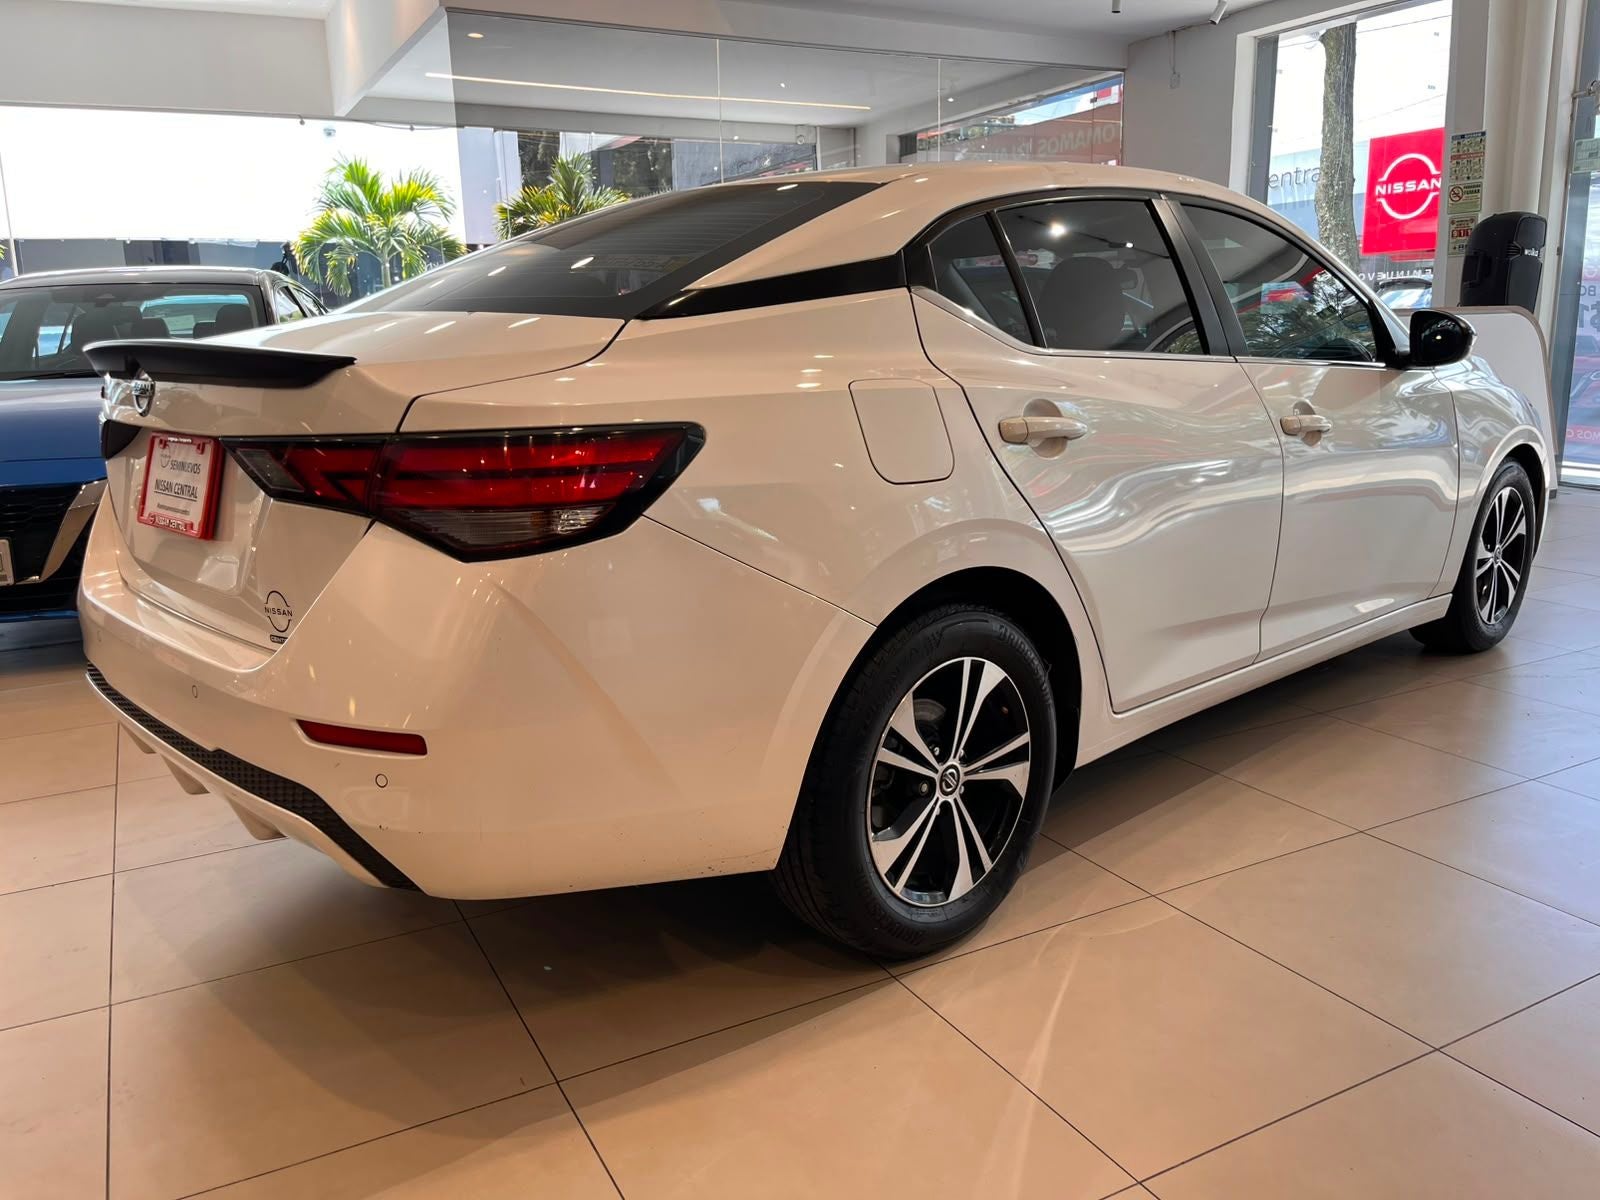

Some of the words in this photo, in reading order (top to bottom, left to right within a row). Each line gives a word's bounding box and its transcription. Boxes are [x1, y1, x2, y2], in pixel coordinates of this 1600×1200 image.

[1375, 178, 1442, 196] NISSAN
[155, 479, 173, 493] NISSAN
[174, 483, 198, 498] CENTRAL
[264, 606, 293, 617] NISSAN
